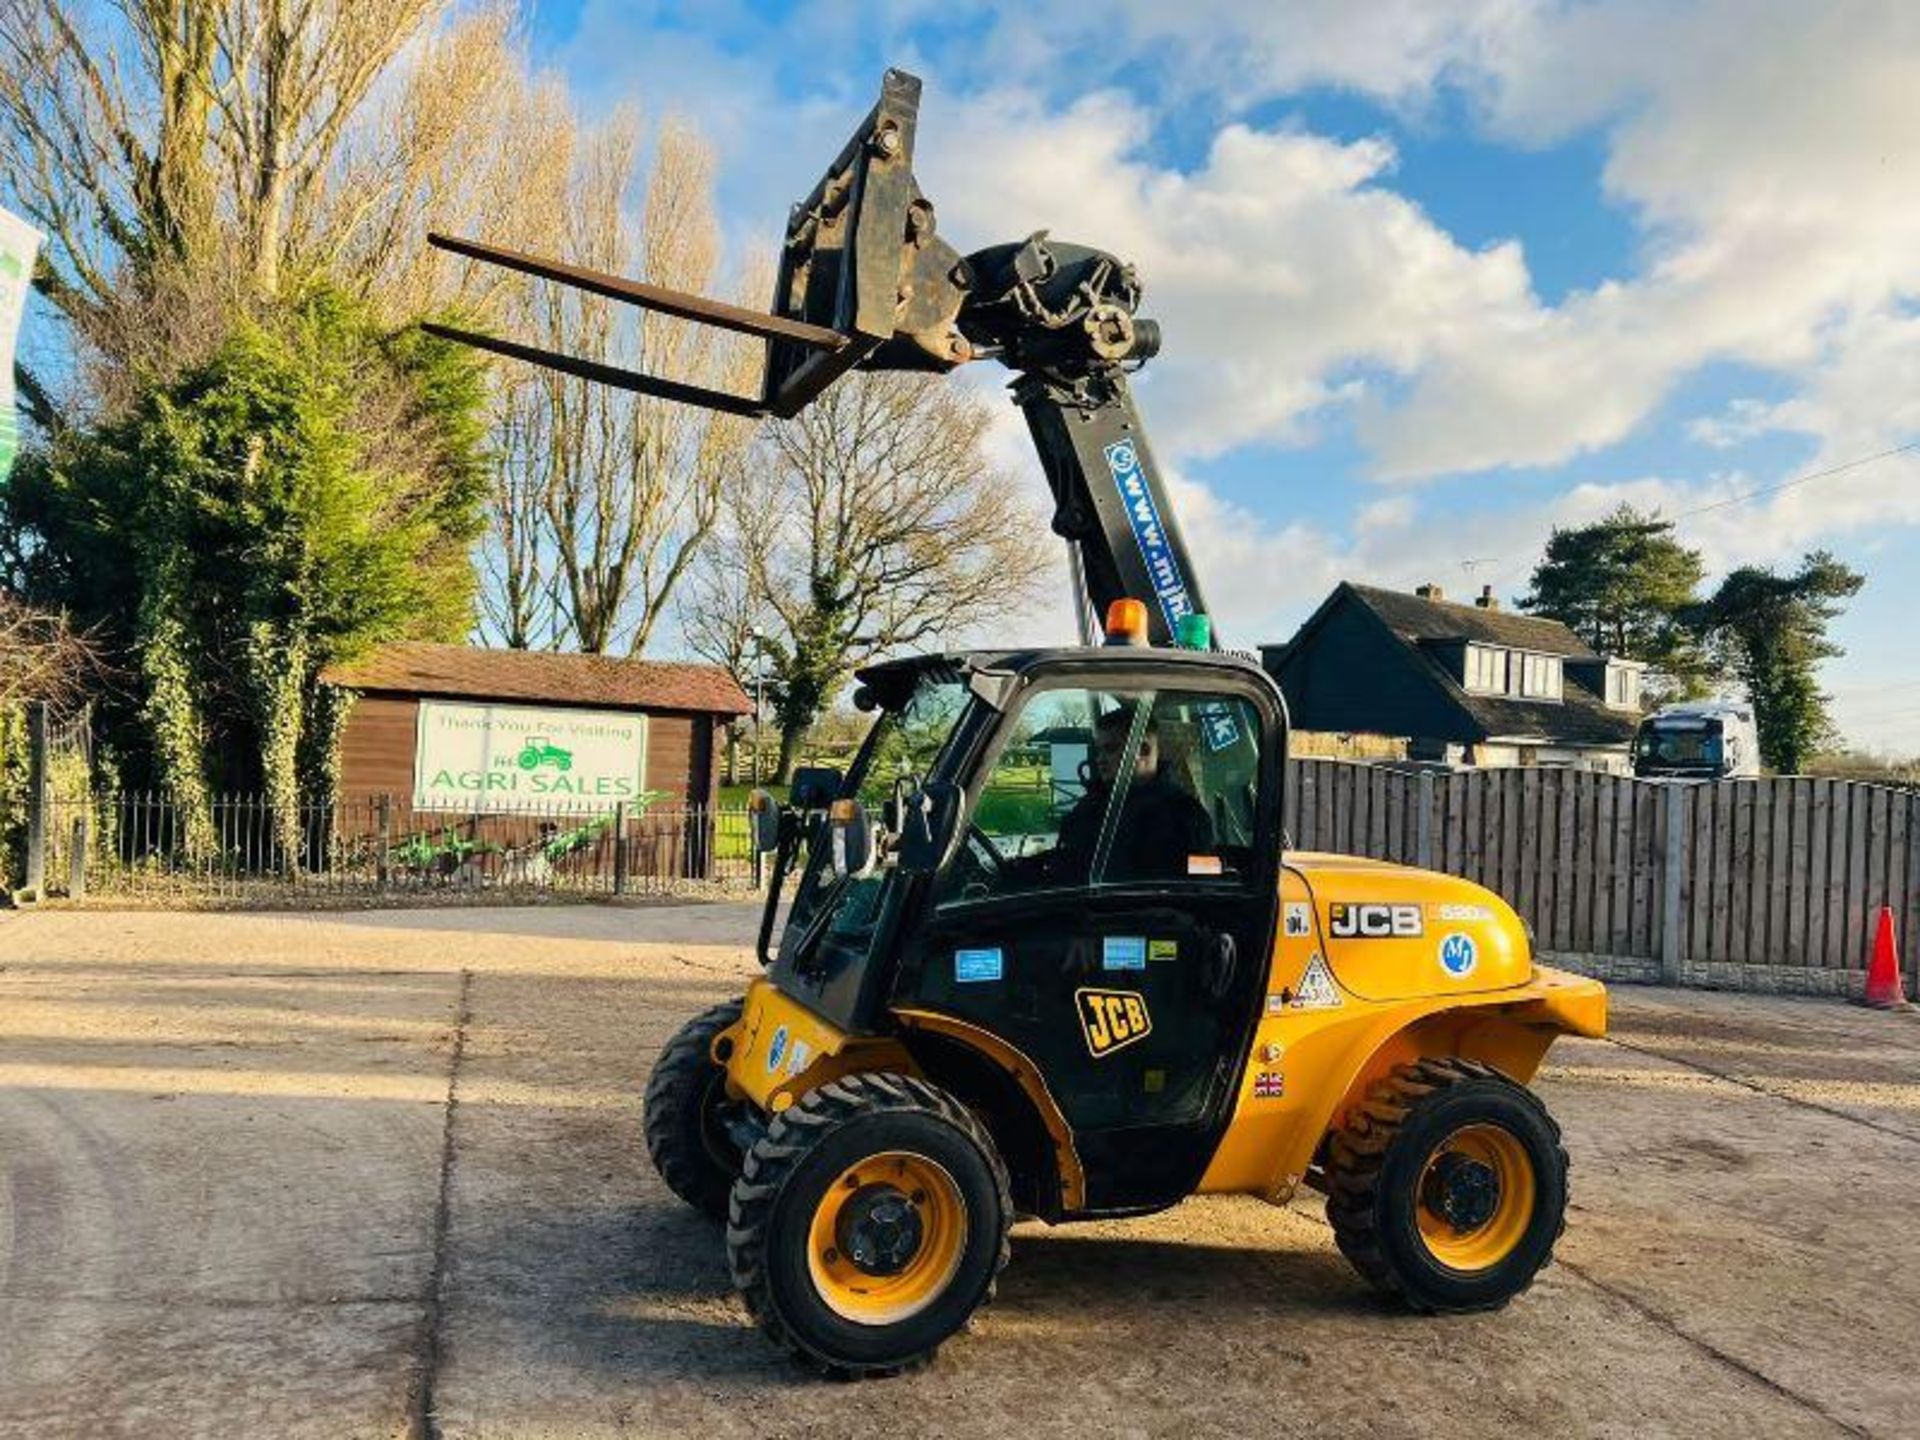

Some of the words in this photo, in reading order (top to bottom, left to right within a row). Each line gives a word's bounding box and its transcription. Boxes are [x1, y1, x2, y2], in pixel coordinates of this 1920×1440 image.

[441, 716, 491, 731] Thank
[497, 719, 532, 732] You
[537, 721, 562, 735] For
[568, 723, 633, 742] Visiting
[430, 769, 518, 791] AGRI
[530, 773, 633, 796] SALES
[1331, 905, 1422, 936] JCB
[1086, 994, 1146, 1050] JCB
